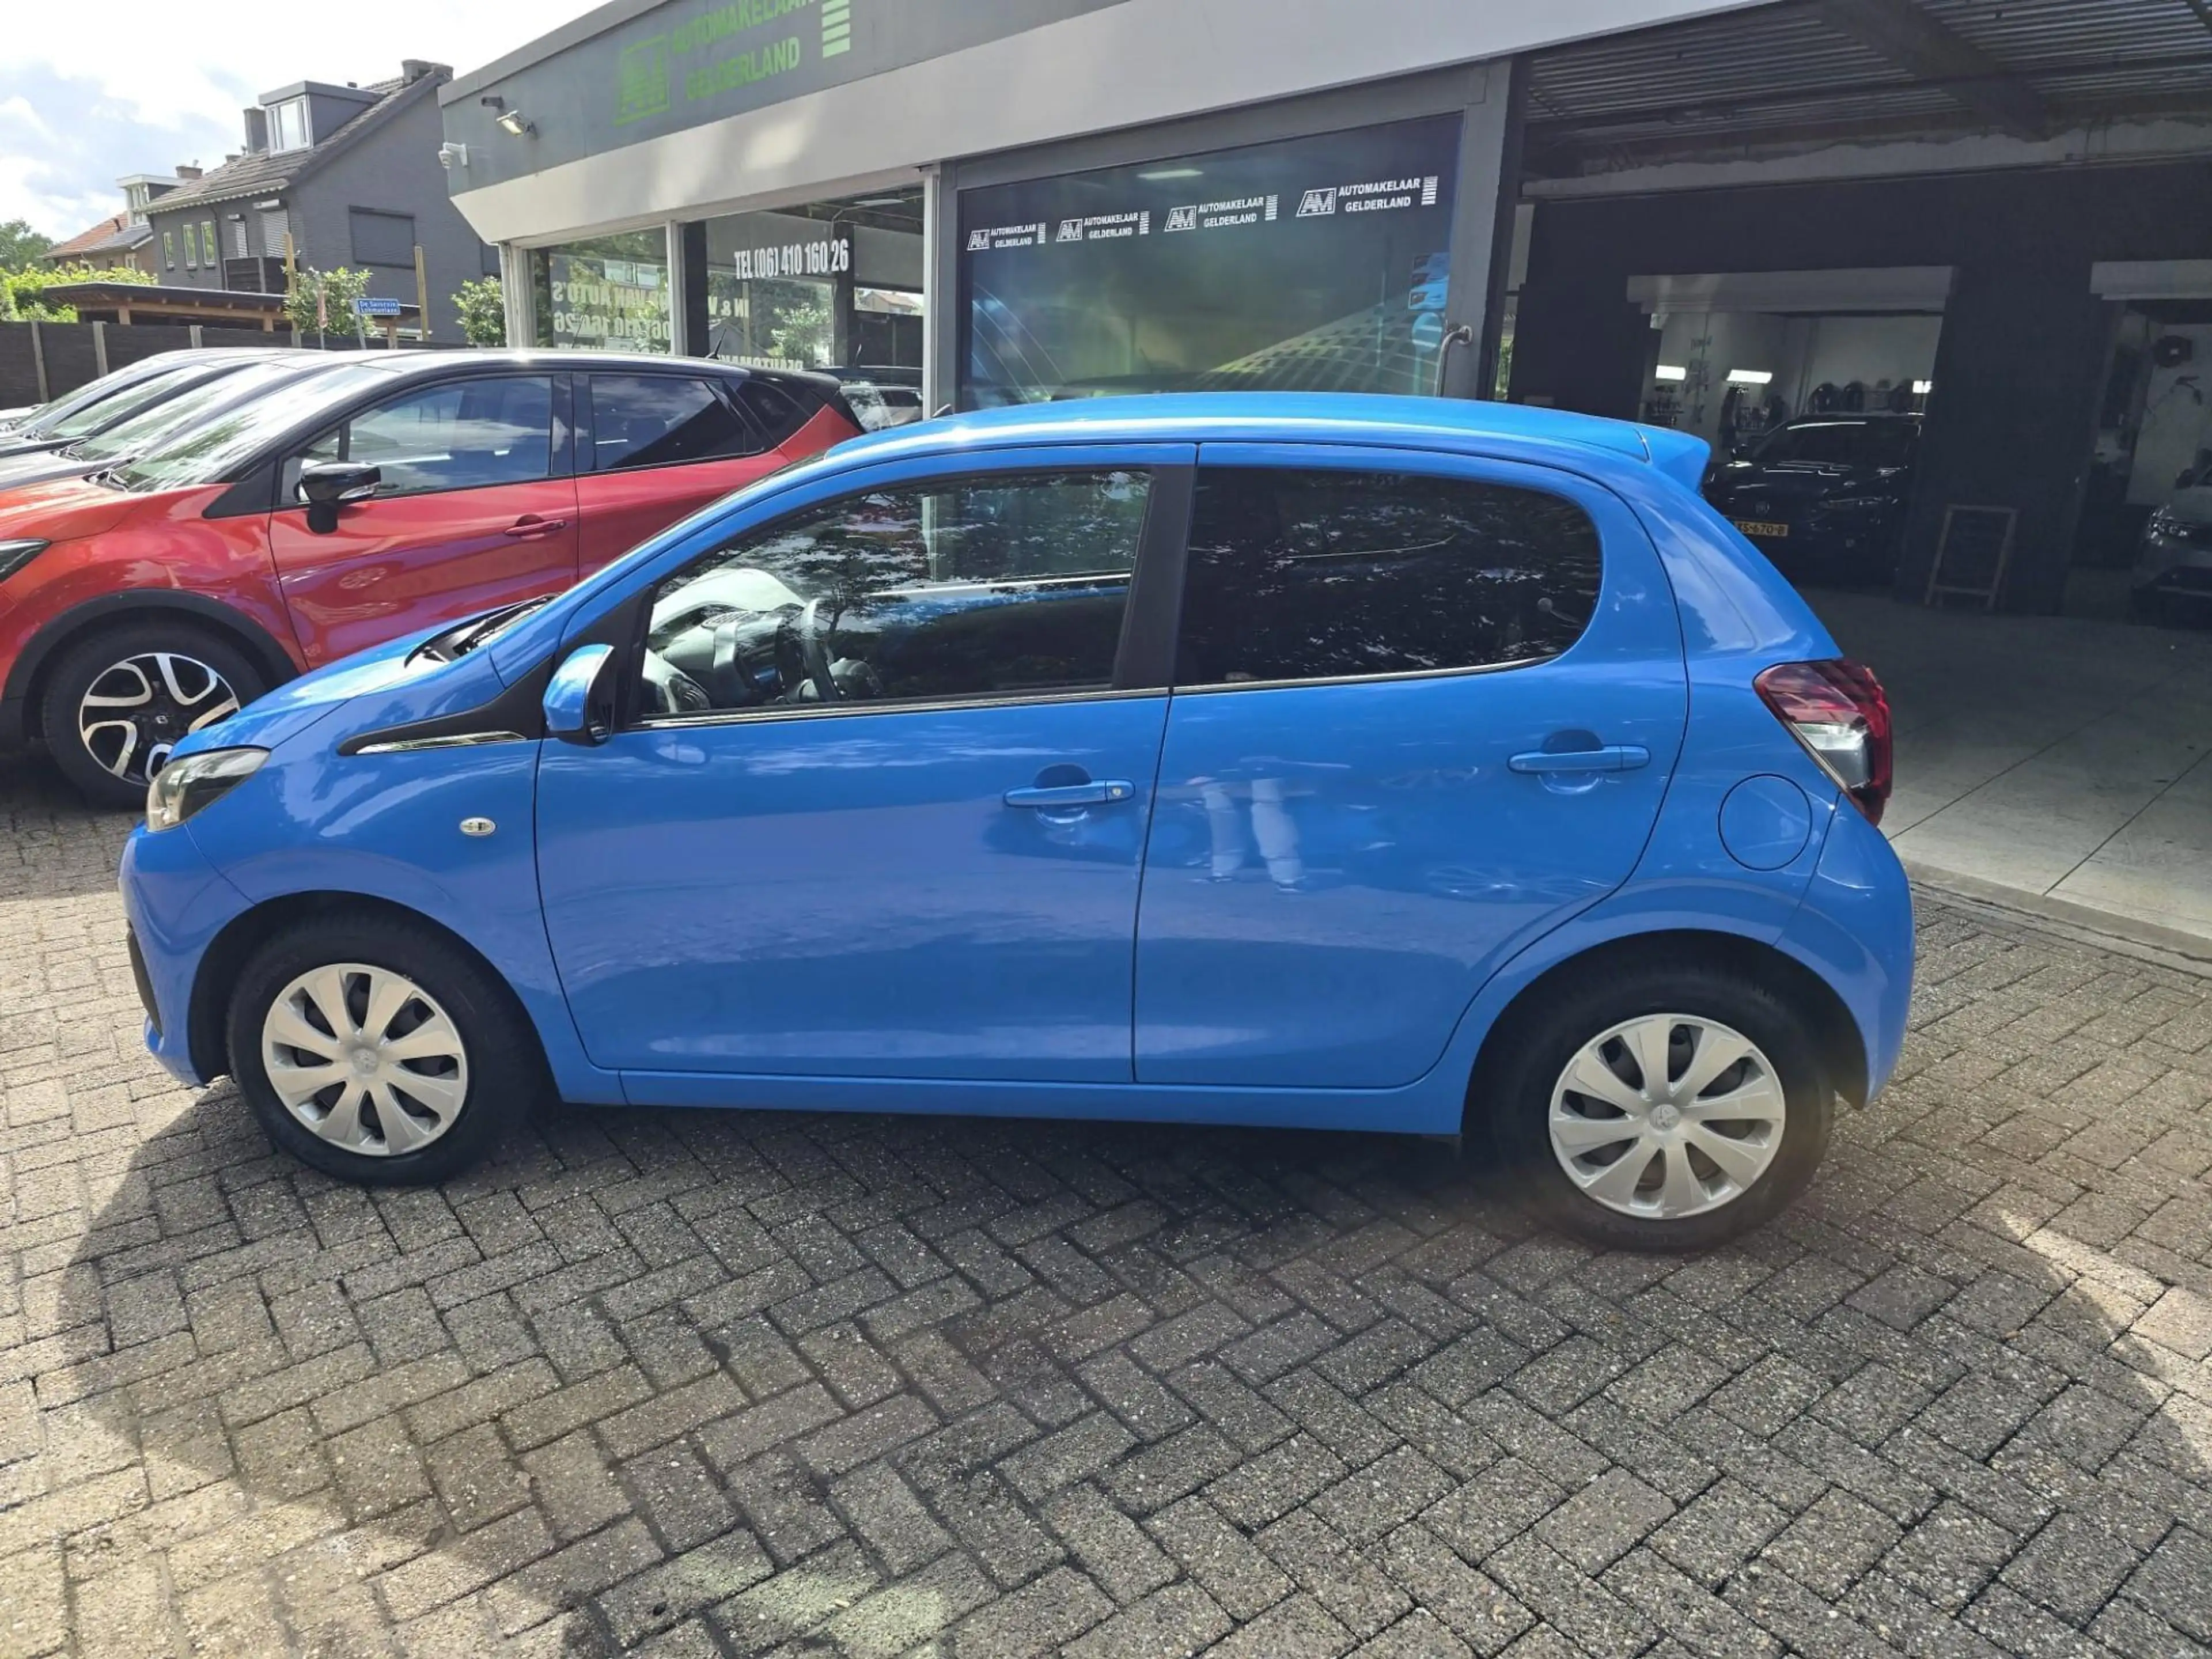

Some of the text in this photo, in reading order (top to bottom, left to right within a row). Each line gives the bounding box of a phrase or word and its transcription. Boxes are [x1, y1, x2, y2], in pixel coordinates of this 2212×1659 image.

[673, 0, 813, 53] AUTOMAKELA
[685, 37, 800, 100] GELDERLAND
[1338, 177, 1421, 196] AUTOMAKELAAR
[1198, 197, 1263, 214] AUTOMAKELAAR
[1345, 196, 1411, 212] GELDERLAND
[1084, 212, 1138, 226] AUTOMAKELAAR
[1204, 213, 1257, 228] GELDERLAND
[1089, 227, 1132, 240] GELDERLAND
[734, 238, 849, 279] TEL (06) 410 160 26
